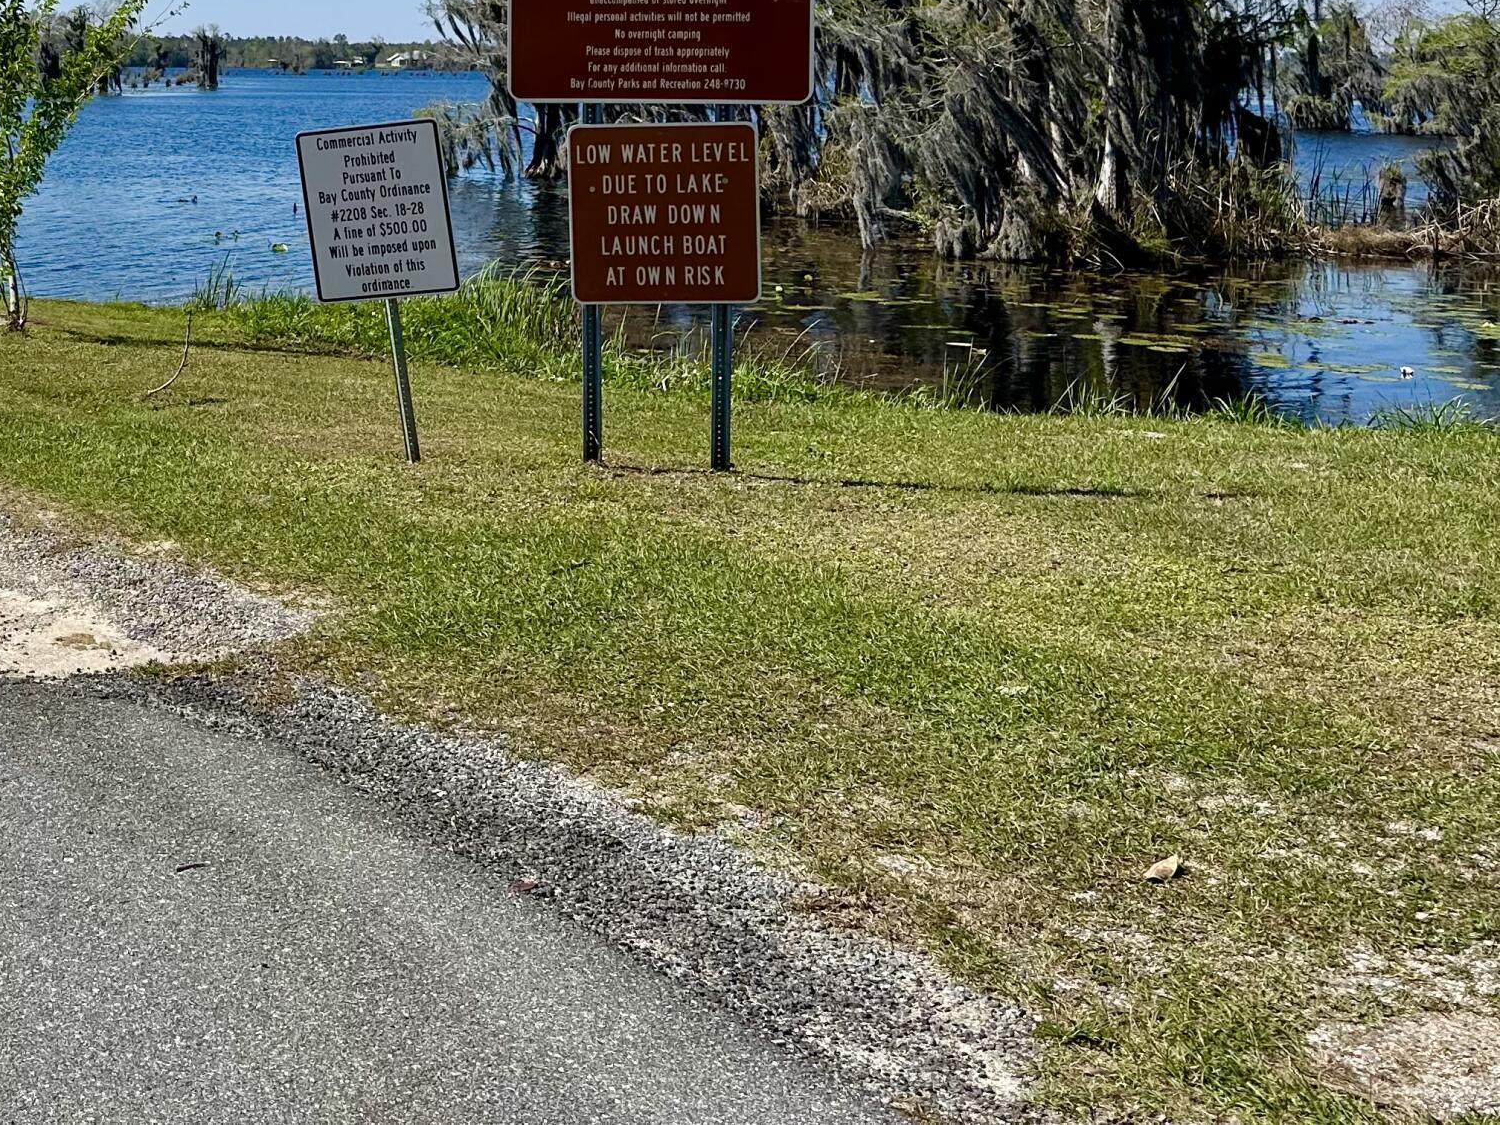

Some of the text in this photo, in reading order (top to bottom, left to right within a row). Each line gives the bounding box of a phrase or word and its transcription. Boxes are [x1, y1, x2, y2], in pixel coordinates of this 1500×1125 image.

[567, 12, 750, 24] Illegal personal activities will not be permitted
[615, 29, 700, 41] No overnight camping
[586, 46, 729, 58] Please dispose of trash appropriately
[588, 62, 600, 72] For
[603, 64, 617, 74] any
[621, 62, 659, 72] additional
[662, 62, 707, 72] information
[571, 79, 585, 90] Bay
[618, 79, 639, 89] Parks
[643, 79, 656, 89] and
[660, 79, 701, 89] Recreation
[316, 129, 417, 151] Commercial Activity
[344, 151, 395, 167] Prohibited
[576, 142, 749, 164] LOW WATER LEVEL
[343, 167, 401, 184] Pursuant To
[603, 174, 724, 194] DUE TO LAKE
[319, 182, 430, 205] Bay County Ordinance
[331, 207, 367, 222] #2208
[395, 202, 424, 217] 18-28
[608, 205, 720, 224] DRAW DOWN
[334, 227, 341, 241] A
[344, 227, 363, 239] fine
[367, 225, 376, 237] of
[329, 239, 436, 259] Will be imposed upon
[602, 235, 726, 256] LAUNCH BOAT
[346, 260, 425, 277] Violation of this
[606, 266, 725, 286] AT OWN RISK
